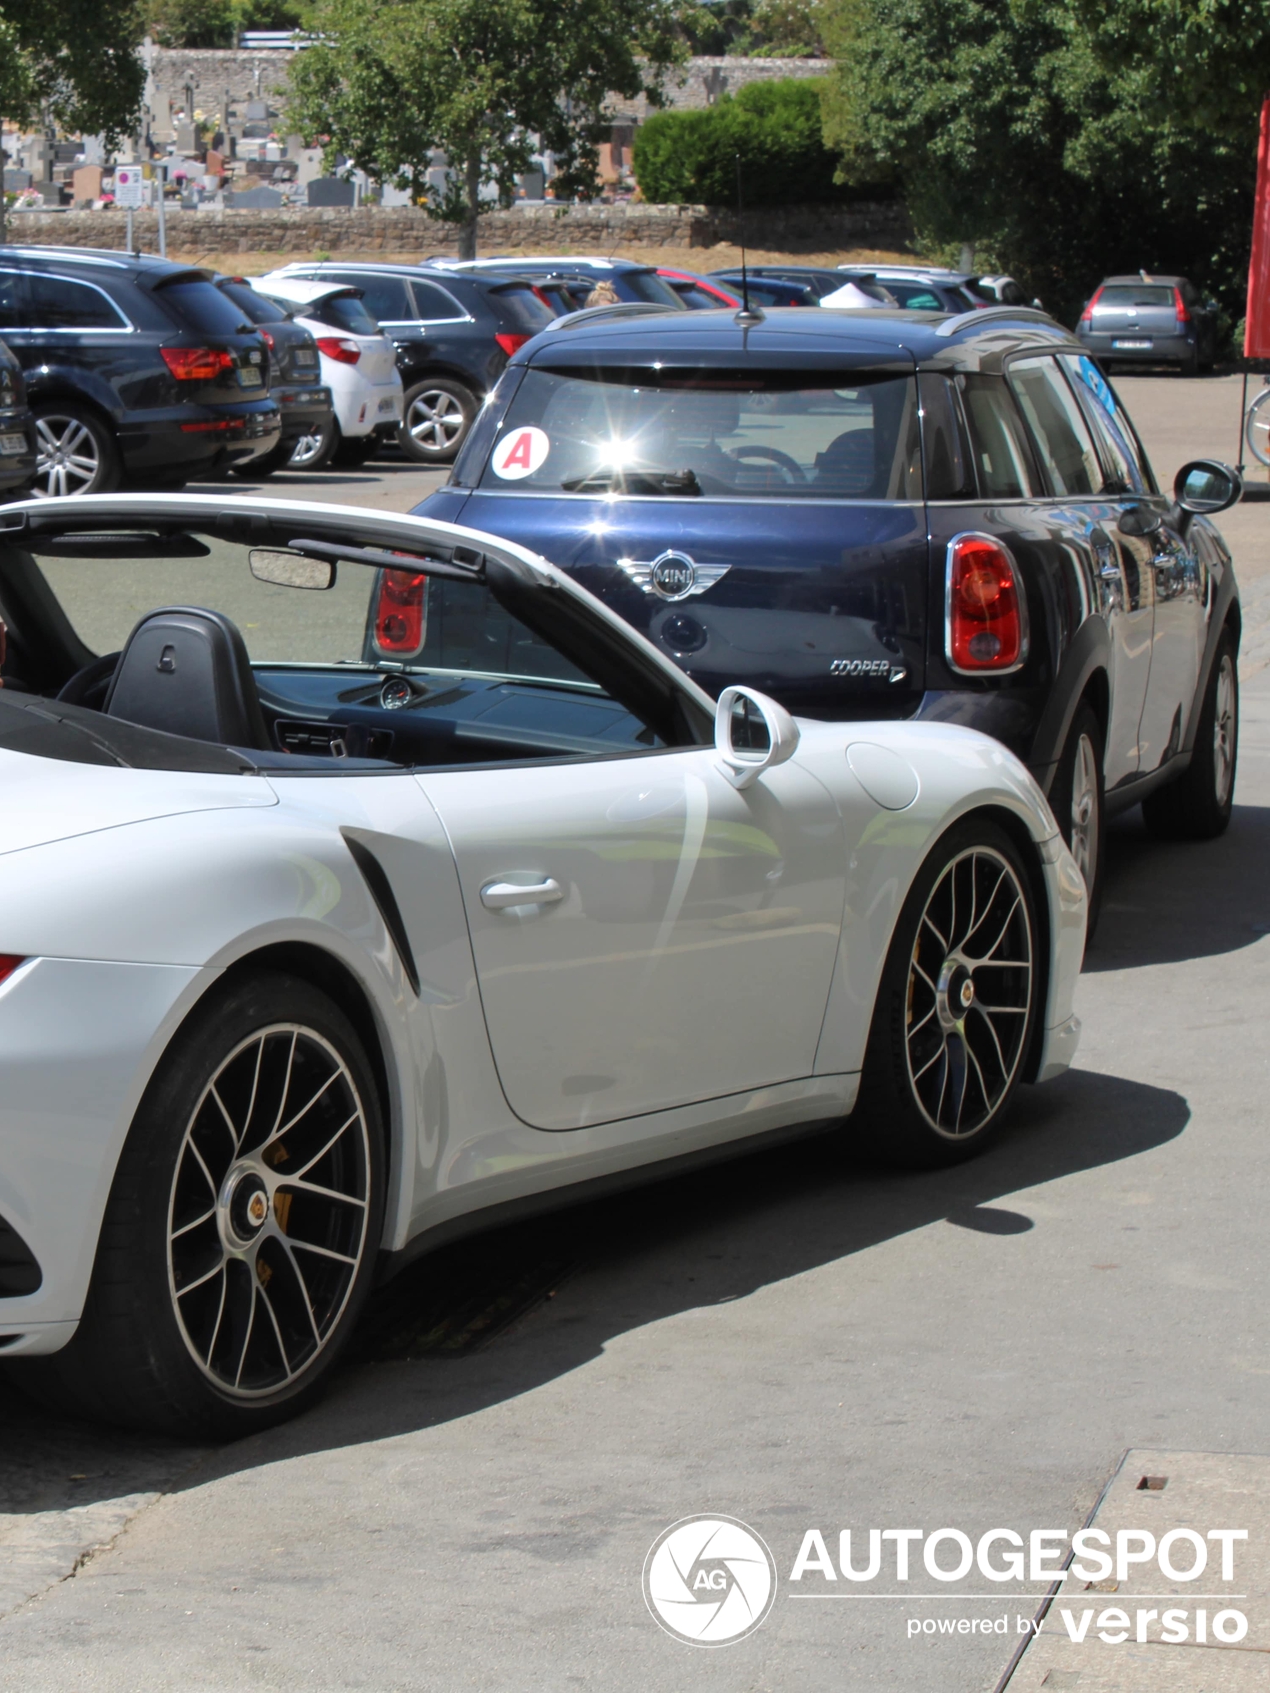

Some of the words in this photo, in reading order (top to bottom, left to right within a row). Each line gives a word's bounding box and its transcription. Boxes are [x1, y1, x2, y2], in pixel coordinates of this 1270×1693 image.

[502, 432, 532, 469] A
[654, 567, 693, 585] MINI
[830, 659, 890, 676] COOPER
